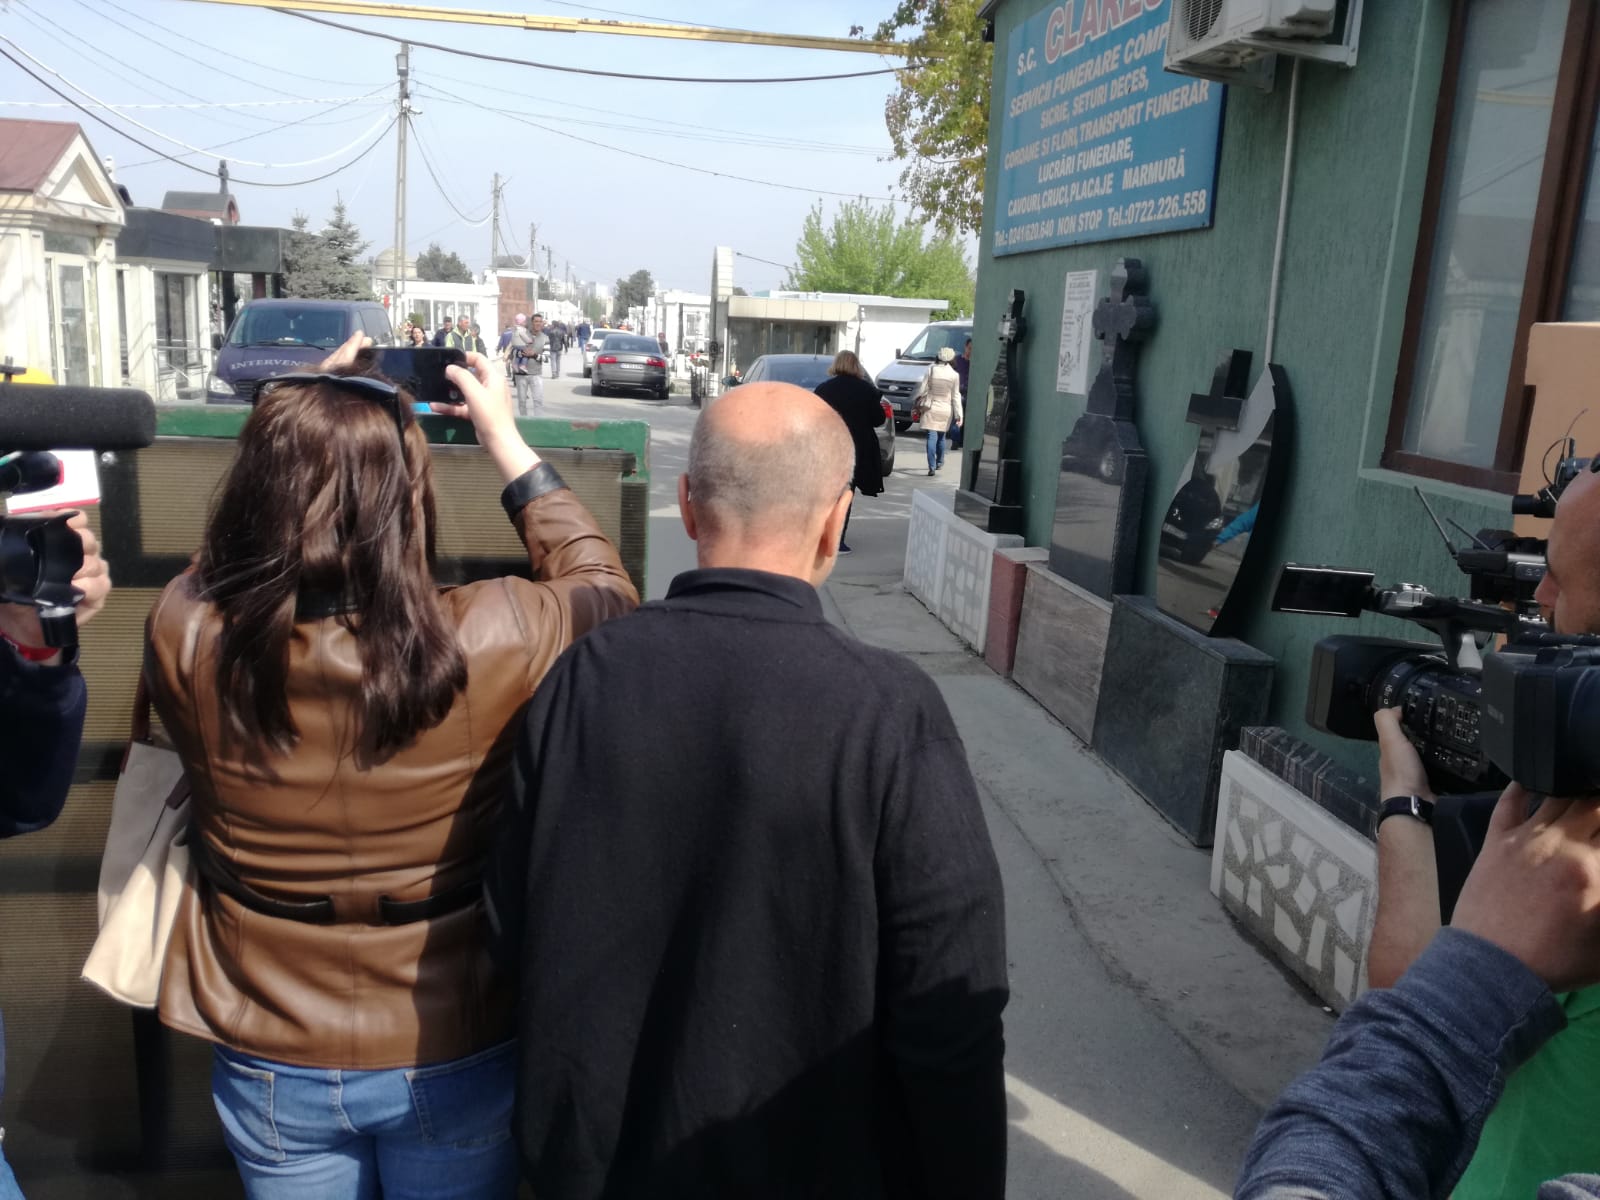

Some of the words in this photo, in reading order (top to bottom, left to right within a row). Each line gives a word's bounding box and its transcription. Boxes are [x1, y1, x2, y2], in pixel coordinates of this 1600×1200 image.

[1017, 48, 1036, 76] S.C.
[1045, 0, 1162, 64] CLAR
[1052, 44, 1122, 99] FUNERARE
[1123, 21, 1169, 64] COMP
[1072, 84, 1107, 116] SETURI
[1110, 66, 1148, 99] DECES,
[1080, 102, 1144, 142] TRANSPORT
[1144, 78, 1210, 121] FUNERAR
[1076, 136, 1134, 172] FUNERARE,
[1122, 148, 1186, 190] MARMURĂ
[1056, 216, 1076, 236] NON
[1077, 208, 1103, 233] STOP
[231, 359, 303, 370] INTERVEN
